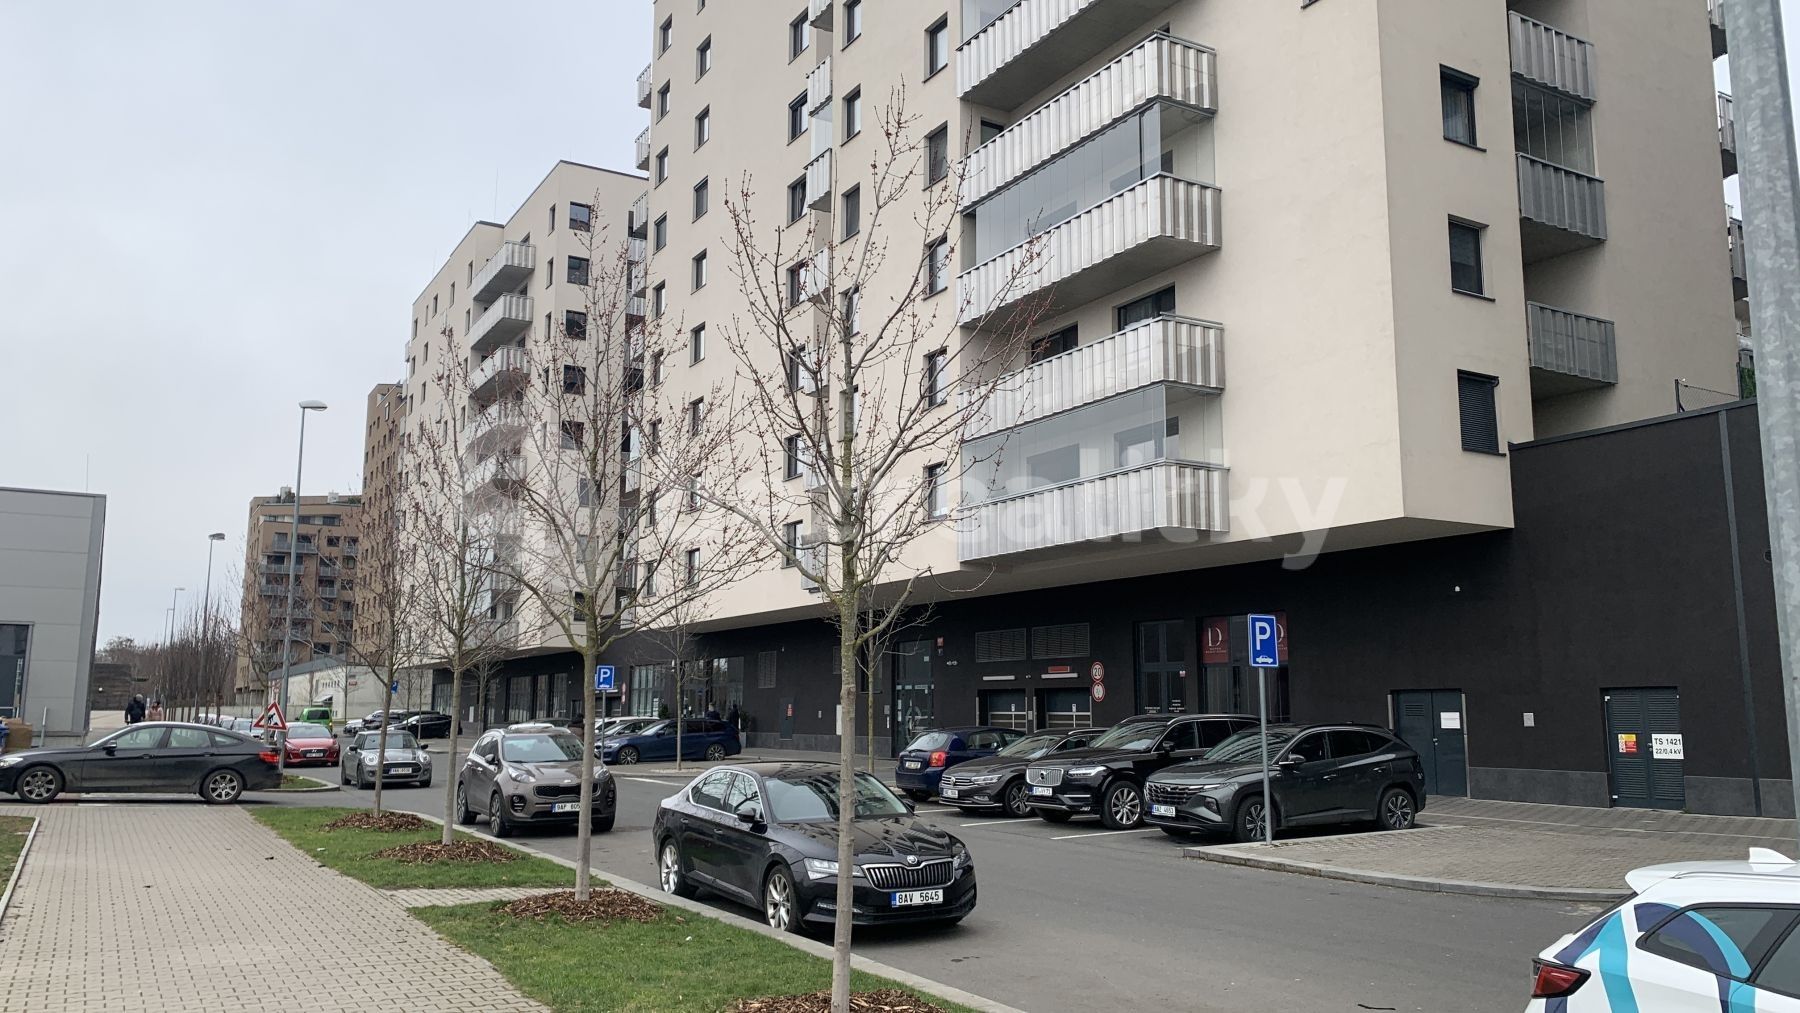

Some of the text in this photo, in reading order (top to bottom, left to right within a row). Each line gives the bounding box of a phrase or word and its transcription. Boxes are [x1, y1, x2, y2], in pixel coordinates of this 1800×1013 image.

[1255, 621, 1271, 651] P
[600, 668, 611, 683] P
[1094, 667, 1102, 677] 20
[1654, 737, 1681, 746] TS 1421
[898, 891, 940, 904] 8AV 5645
